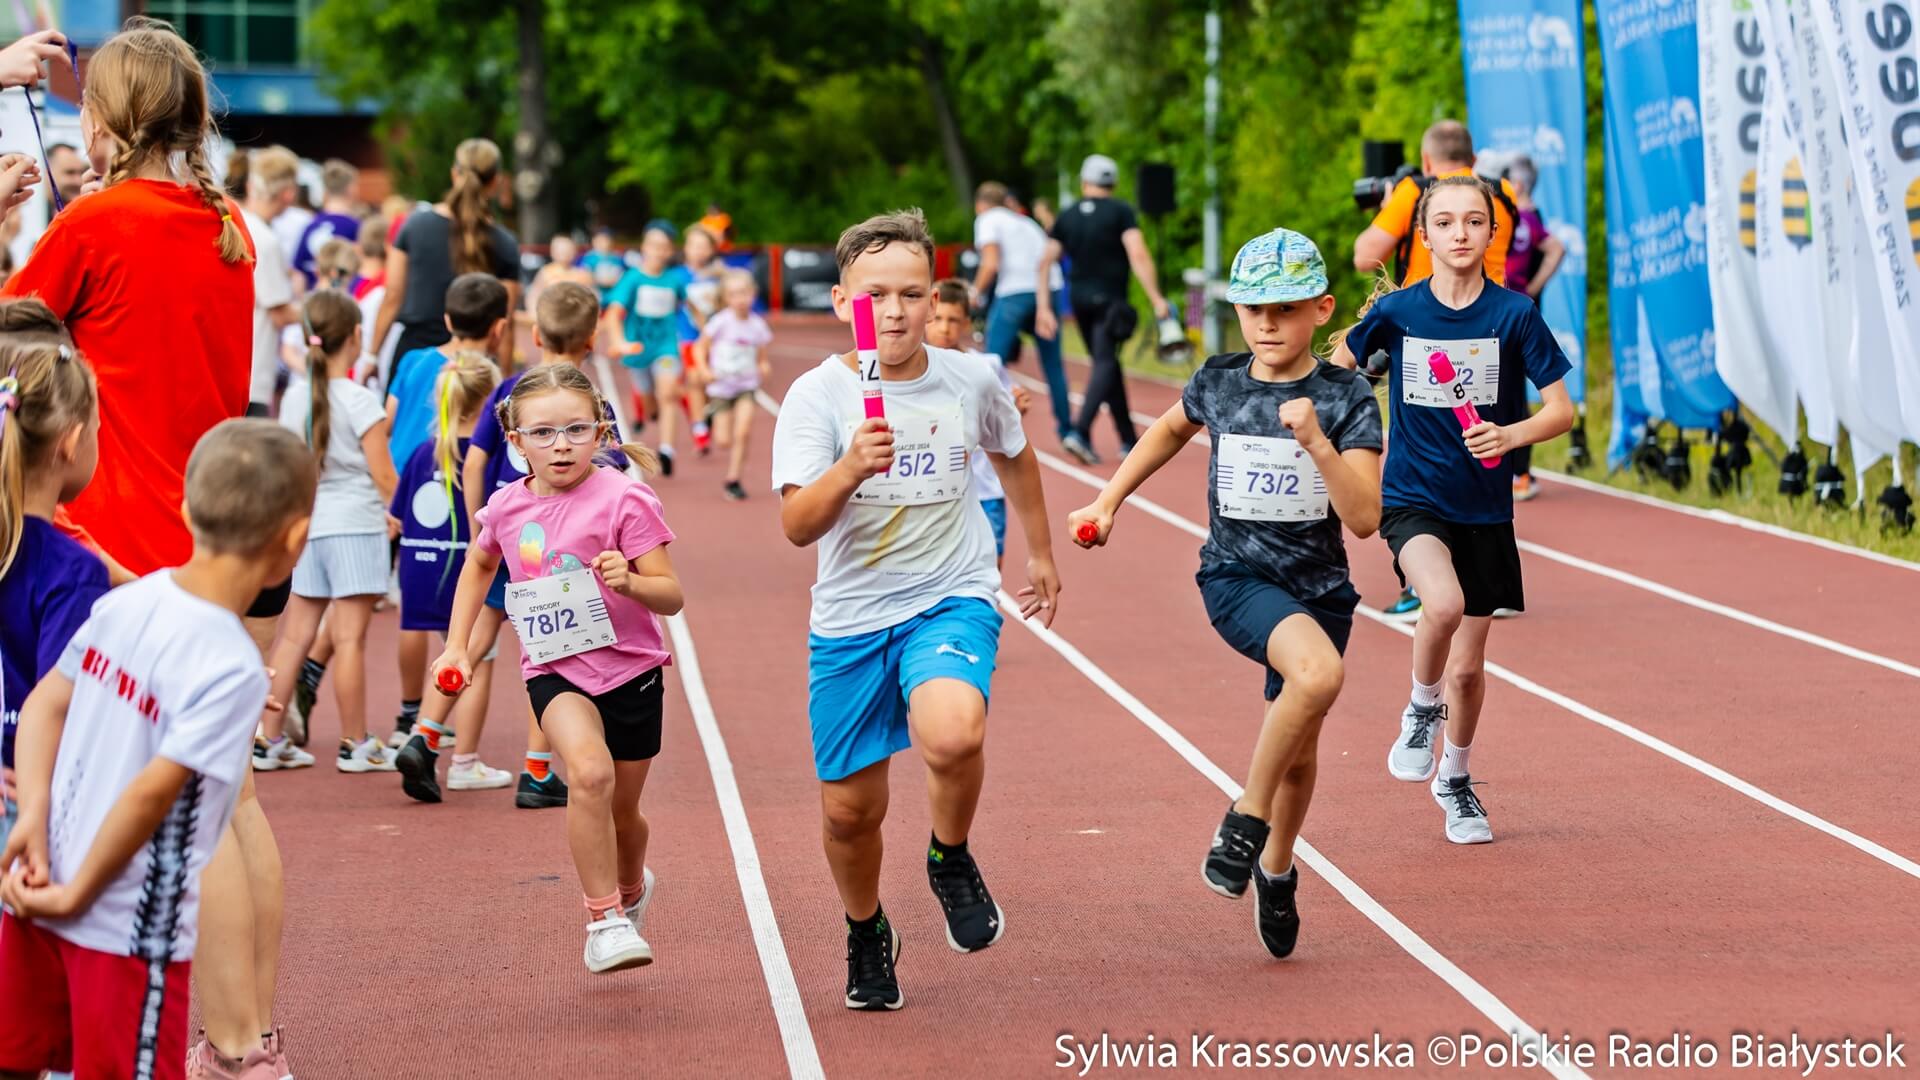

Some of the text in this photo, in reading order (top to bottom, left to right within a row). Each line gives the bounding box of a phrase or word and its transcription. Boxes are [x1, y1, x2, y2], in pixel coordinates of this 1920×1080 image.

[1271, 463, 1297, 471] TRAMPKI
[1246, 471, 1300, 495] 73/2
[523, 607, 579, 639] 78/2
